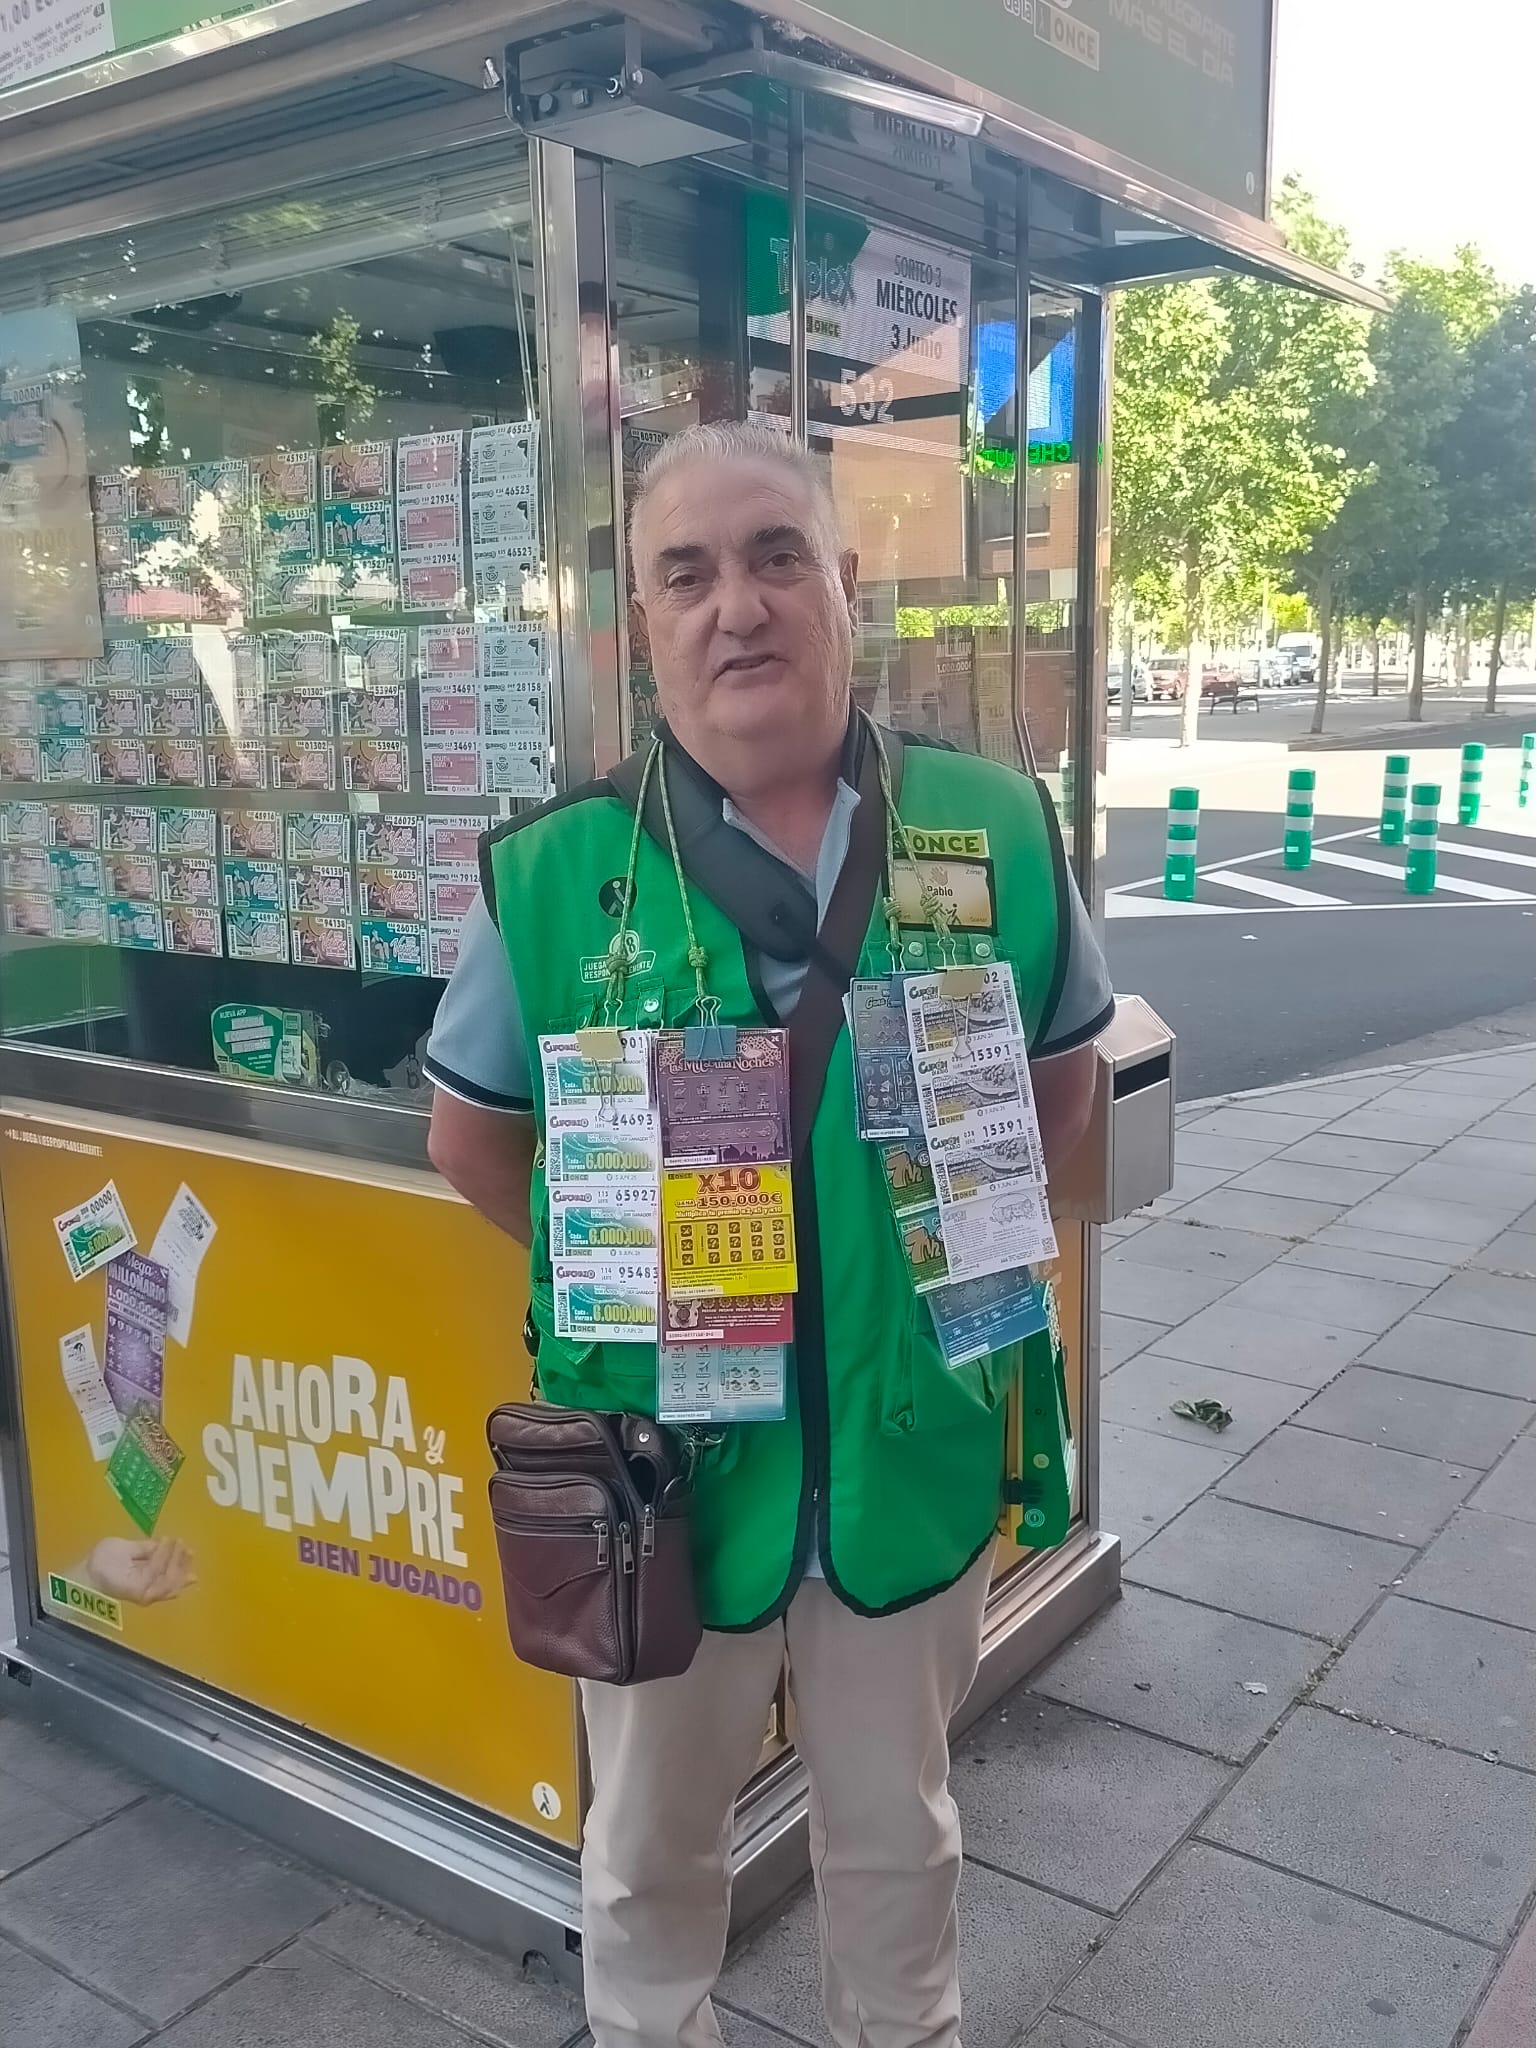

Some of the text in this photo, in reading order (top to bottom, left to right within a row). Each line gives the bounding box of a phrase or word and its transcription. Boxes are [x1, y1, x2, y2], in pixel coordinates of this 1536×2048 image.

[1054, 18, 1095, 60] ONCE
[894, 255, 942, 287] SORTEO 3
[877, 279, 958, 324] MIÉRCOLES
[814, 322, 841, 338] ONCE
[891, 324, 943, 359] 3 Junio
[840, 368, 894, 423] 532
[507, 424, 532, 434] 46523
[505, 485, 530, 496] 46523
[431, 494, 454, 504] 27934
[507, 547, 532, 556] 46523
[432, 554, 456, 563] 27934
[302, 634, 323, 642] 01302
[302, 688, 323, 696] 01302
[452, 684, 476, 693] 34691
[517, 683, 541, 692] 28158
[377, 742, 400, 750] 53949
[454, 742, 477, 750] 34691
[518, 742, 542, 751] 28158
[191, 810, 209, 819] 10961
[394, 817, 416, 825] 26075
[459, 818, 481, 827] 79126
[912, 835, 980, 853] ONCE
[191, 860, 209, 868] 10961
[394, 871, 416, 879] 26075
[194, 909, 213, 917] 10961
[397, 925, 418, 933] 26075
[935, 1040, 954, 1049] ONCE
[971, 1044, 1011, 1063] 15391
[612, 1114, 653, 1126] 24693
[946, 1113, 965, 1124] ONCE
[983, 1118, 1023, 1137] 15391
[698, 1168, 760, 1194] x10
[616, 1190, 657, 1202] 65927
[697, 1193, 783, 1209] 150.000€
[90, 1190, 113, 1214] 00000
[127, 1254, 152, 1277] Mega
[619, 1267, 658, 1279] 95483
[108, 1262, 166, 1304] MILLONARIO
[232, 1354, 416, 1452] AHORA
[202, 1423, 468, 1567] SIEMPRE
[298, 1536, 483, 1611] BIEN JUGADO
[70, 1587, 120, 1622] ONCE
